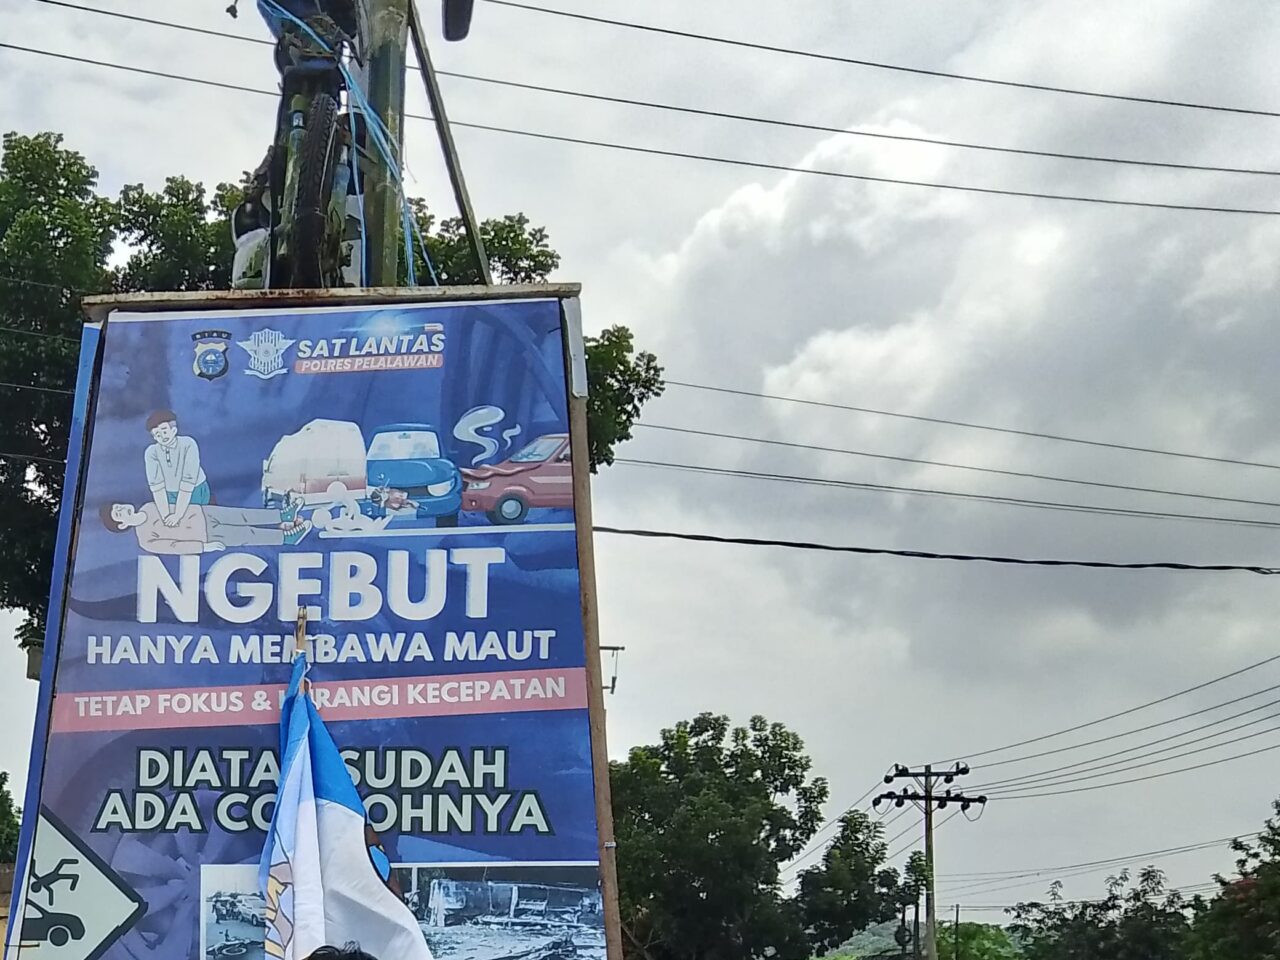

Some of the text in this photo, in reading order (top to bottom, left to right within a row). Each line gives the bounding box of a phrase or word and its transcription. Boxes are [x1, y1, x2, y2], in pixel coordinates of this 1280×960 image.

[297, 333, 446, 358] SAT LANTAS
[302, 354, 439, 372] POLRES PELALAWAN
[135, 546, 506, 624] NGEBUT
[87, 634, 220, 664] HANYA
[443, 629, 557, 661] MAUT
[75, 694, 151, 717] TETAP
[157, 691, 245, 714] FOKUS
[251, 690, 273, 711] &
[406, 676, 566, 705] KECEPATAN
[138, 749, 280, 788] DIATA
[95, 792, 550, 832] ADA COOHNYA
